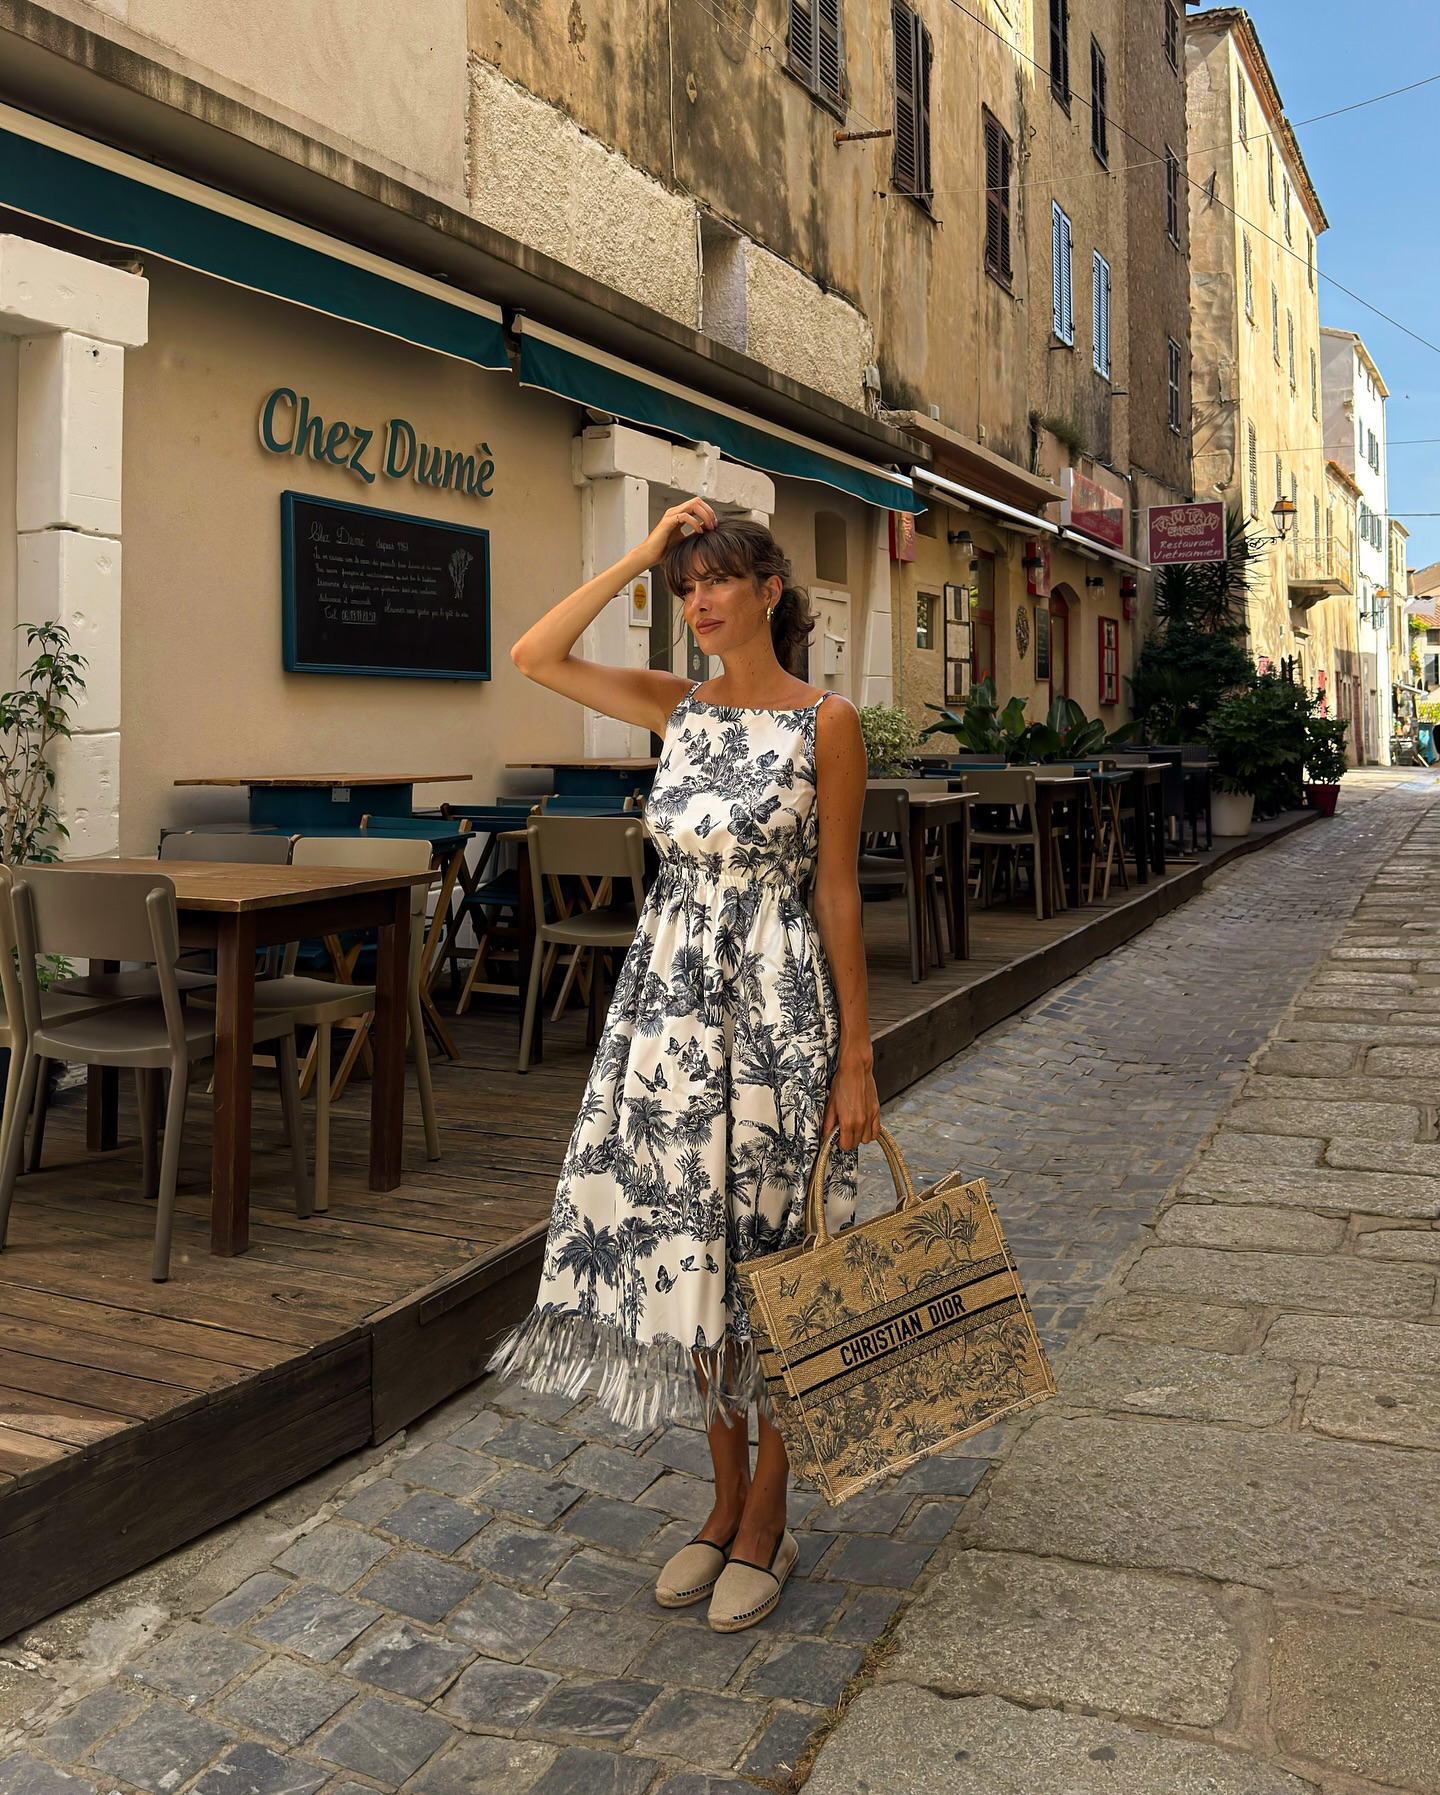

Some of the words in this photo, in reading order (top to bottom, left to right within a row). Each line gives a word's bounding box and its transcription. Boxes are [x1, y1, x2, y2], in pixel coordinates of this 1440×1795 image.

[258, 387, 375, 484] Chez
[382, 418, 495, 498] Dumè
[1167, 525, 1205, 537] SAIGON
[1160, 537, 1215, 549] Restaurant
[1153, 549, 1221, 560] Vietnamien
[840, 1312, 923, 1367] CHRISTIAN
[928, 1294, 966, 1326] DIOR
